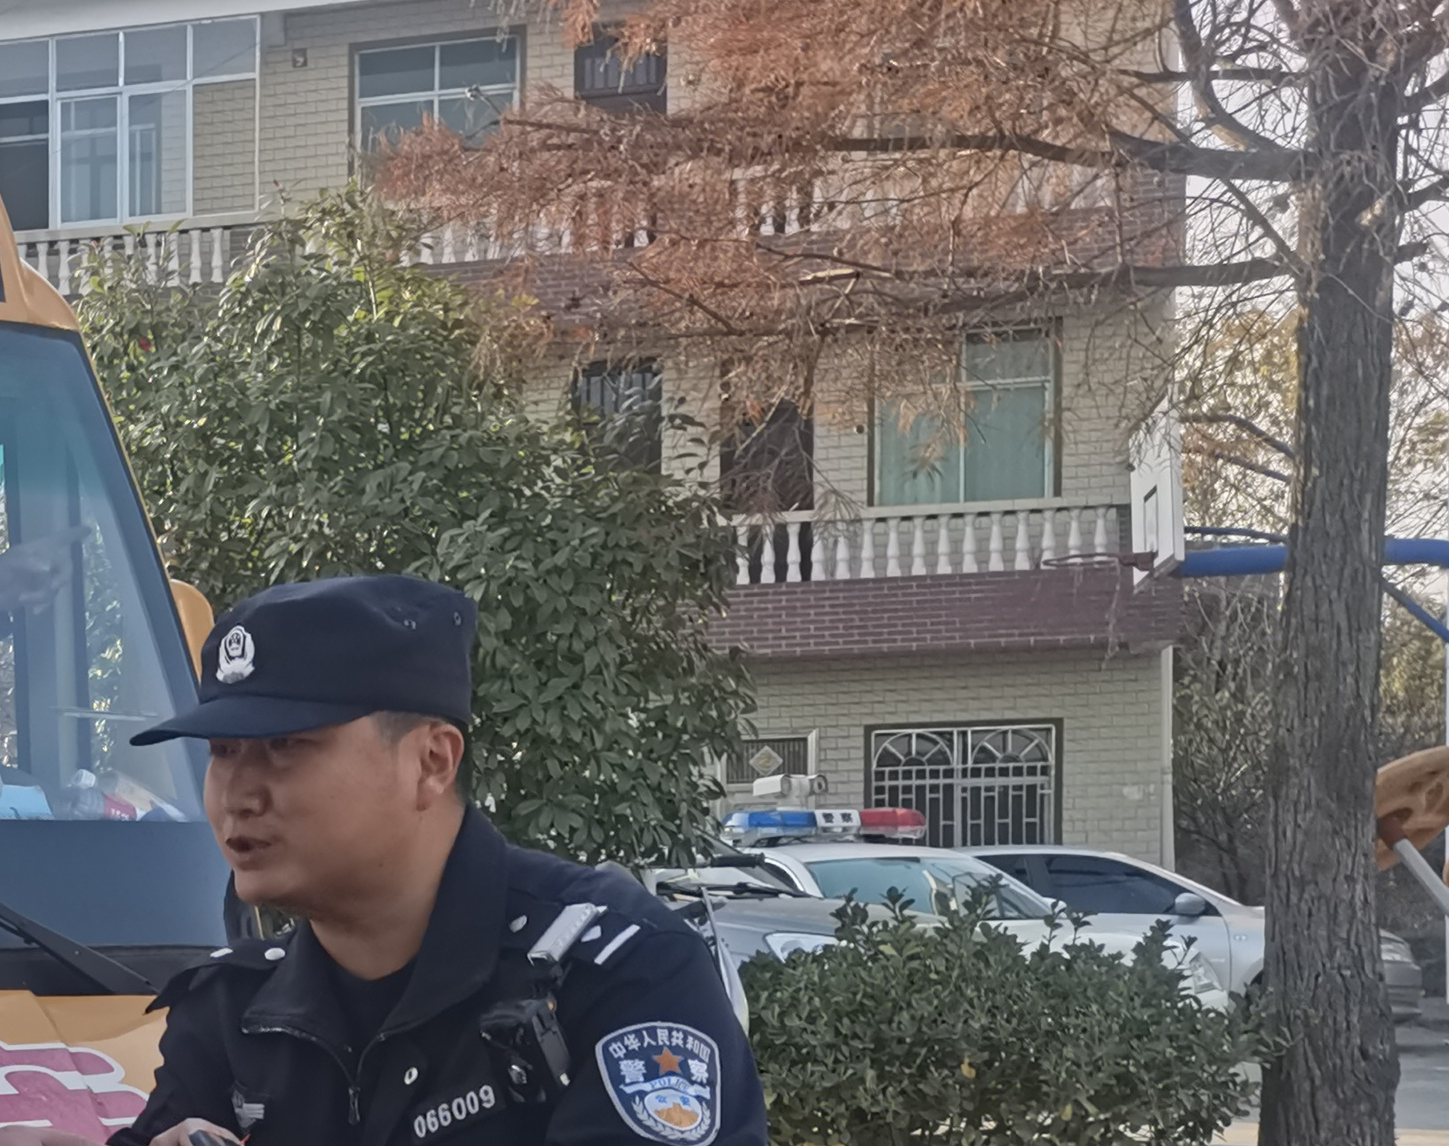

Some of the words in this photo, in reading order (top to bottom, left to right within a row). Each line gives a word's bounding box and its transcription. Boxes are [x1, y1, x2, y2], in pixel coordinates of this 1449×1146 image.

[822, 812, 853, 824] 警察
[608, 1028, 710, 1062] 中华人民共和国
[619, 1059, 709, 1084] 警察
[650, 1077, 690, 1092] POLICE
[413, 1084, 496, 1138] 066009
